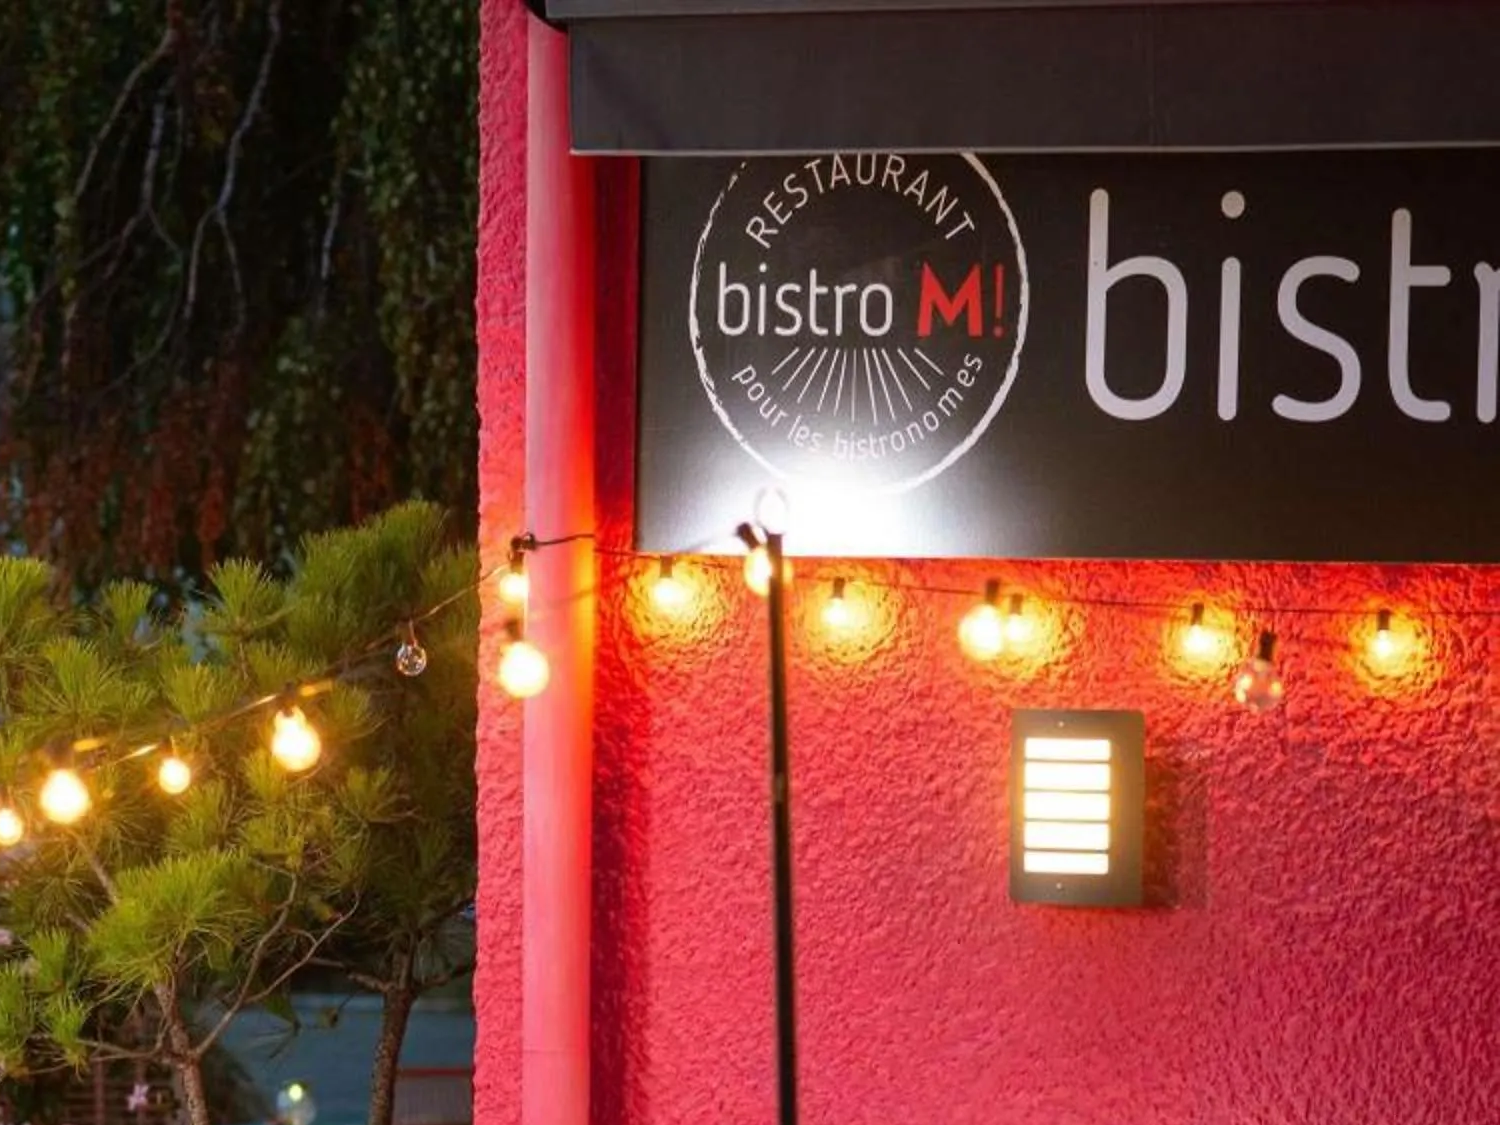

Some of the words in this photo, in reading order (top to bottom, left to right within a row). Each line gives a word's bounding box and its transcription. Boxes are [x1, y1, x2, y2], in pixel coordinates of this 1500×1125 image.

[745, 152, 976, 249] RESTAURANT
[717, 261, 894, 337] bistro
[916, 261, 1005, 338] M!
[1085, 187, 1500, 424] bistr
[731, 364, 789, 428] pour
[787, 415, 825, 451] les
[832, 352, 984, 461] bistronomes
